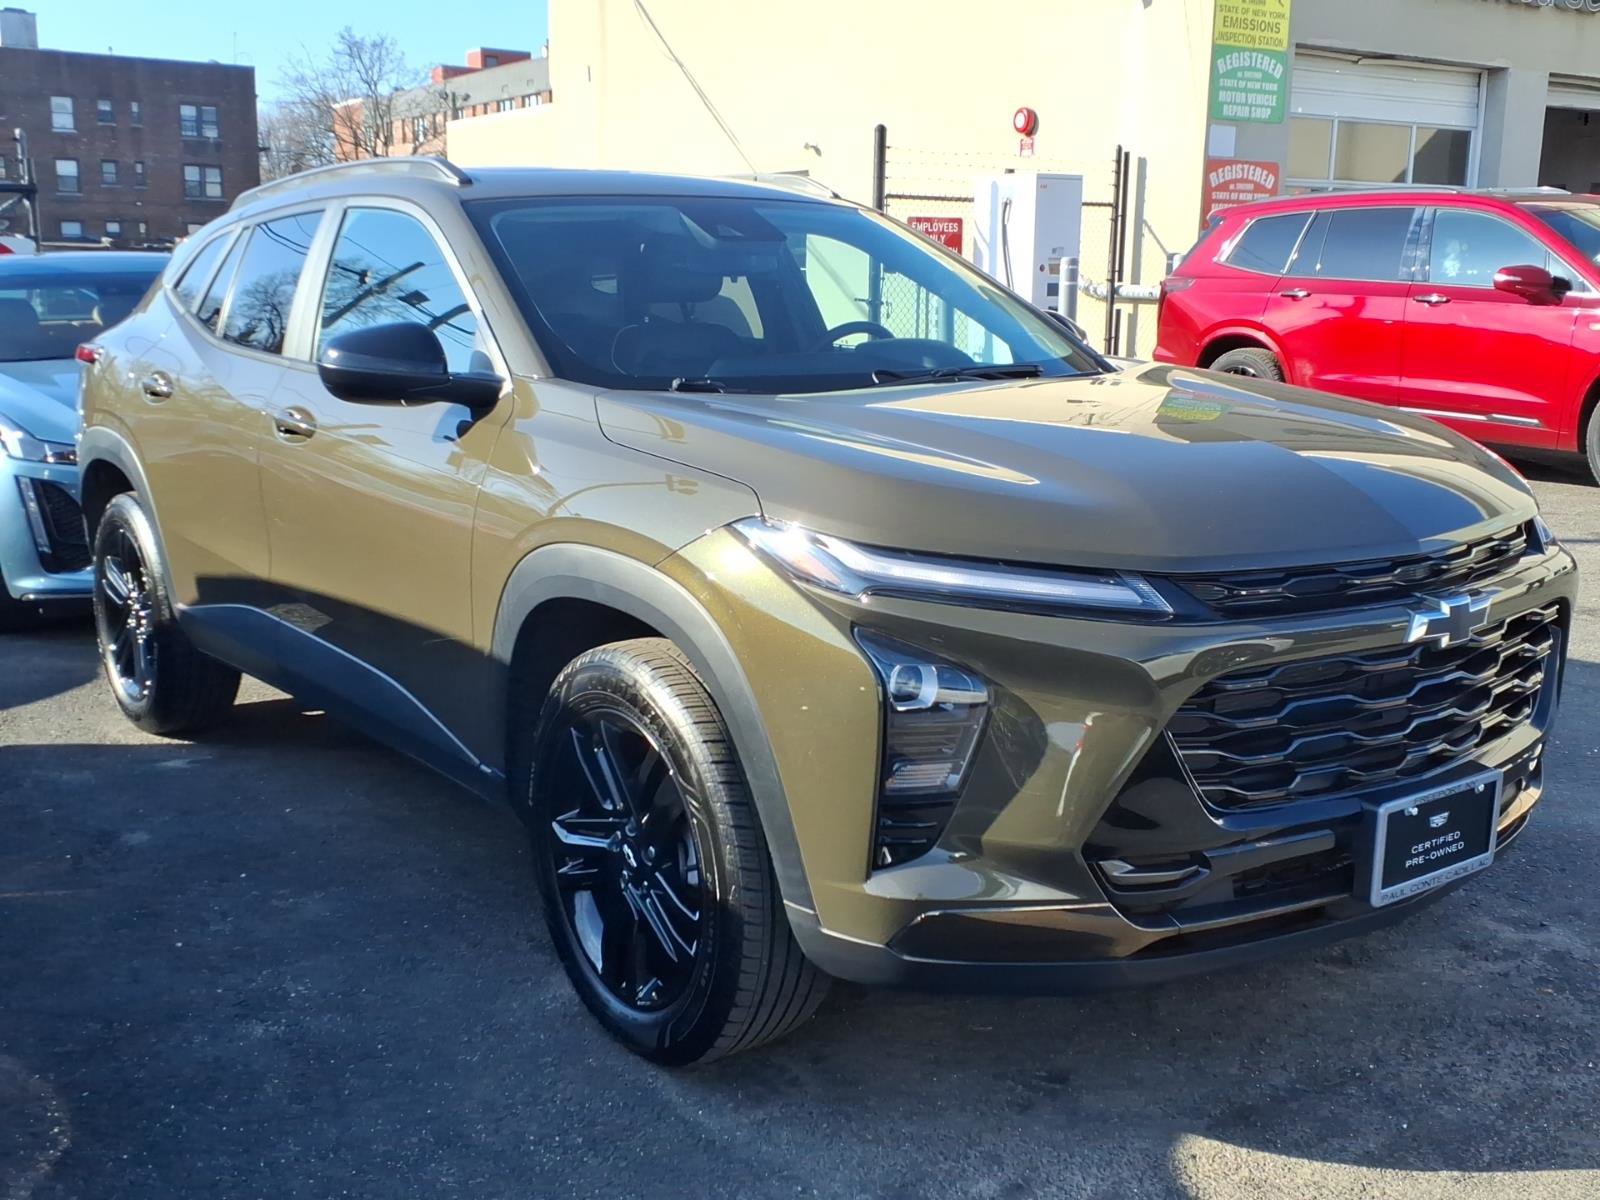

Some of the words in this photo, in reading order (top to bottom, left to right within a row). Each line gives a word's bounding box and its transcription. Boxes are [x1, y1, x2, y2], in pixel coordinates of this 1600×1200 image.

[1219, 5, 1239, 14] STATE
[1241, 7, 1250, 15] OF
[1252, 9, 1267, 17] NEW
[1223, 15, 1281, 34] EMISSIONS
[1258, 35, 1283, 47] STATION
[1217, 51, 1284, 79] REGISTERED
[1219, 78, 1237, 87] STATE
[1238, 80, 1246, 89] OF
[1247, 81, 1261, 90] NEW
[1262, 82, 1278, 91] YORK
[1219, 90, 1247, 104] MOTOR
[1247, 93, 1278, 106] VEHICLE
[1222, 104, 1250, 117] REPAIR
[1250, 106, 1272, 119] SHOP
[1209, 164, 1275, 189] REGISTERED
[1211, 191, 1230, 200] STATE
[1231, 192, 1238, 200] OF
[911, 222, 959, 232] EMPLOYEES
[1411, 831, 1461, 854] CERTIFIED
[1404, 841, 1465, 868] PRE-OWNED
